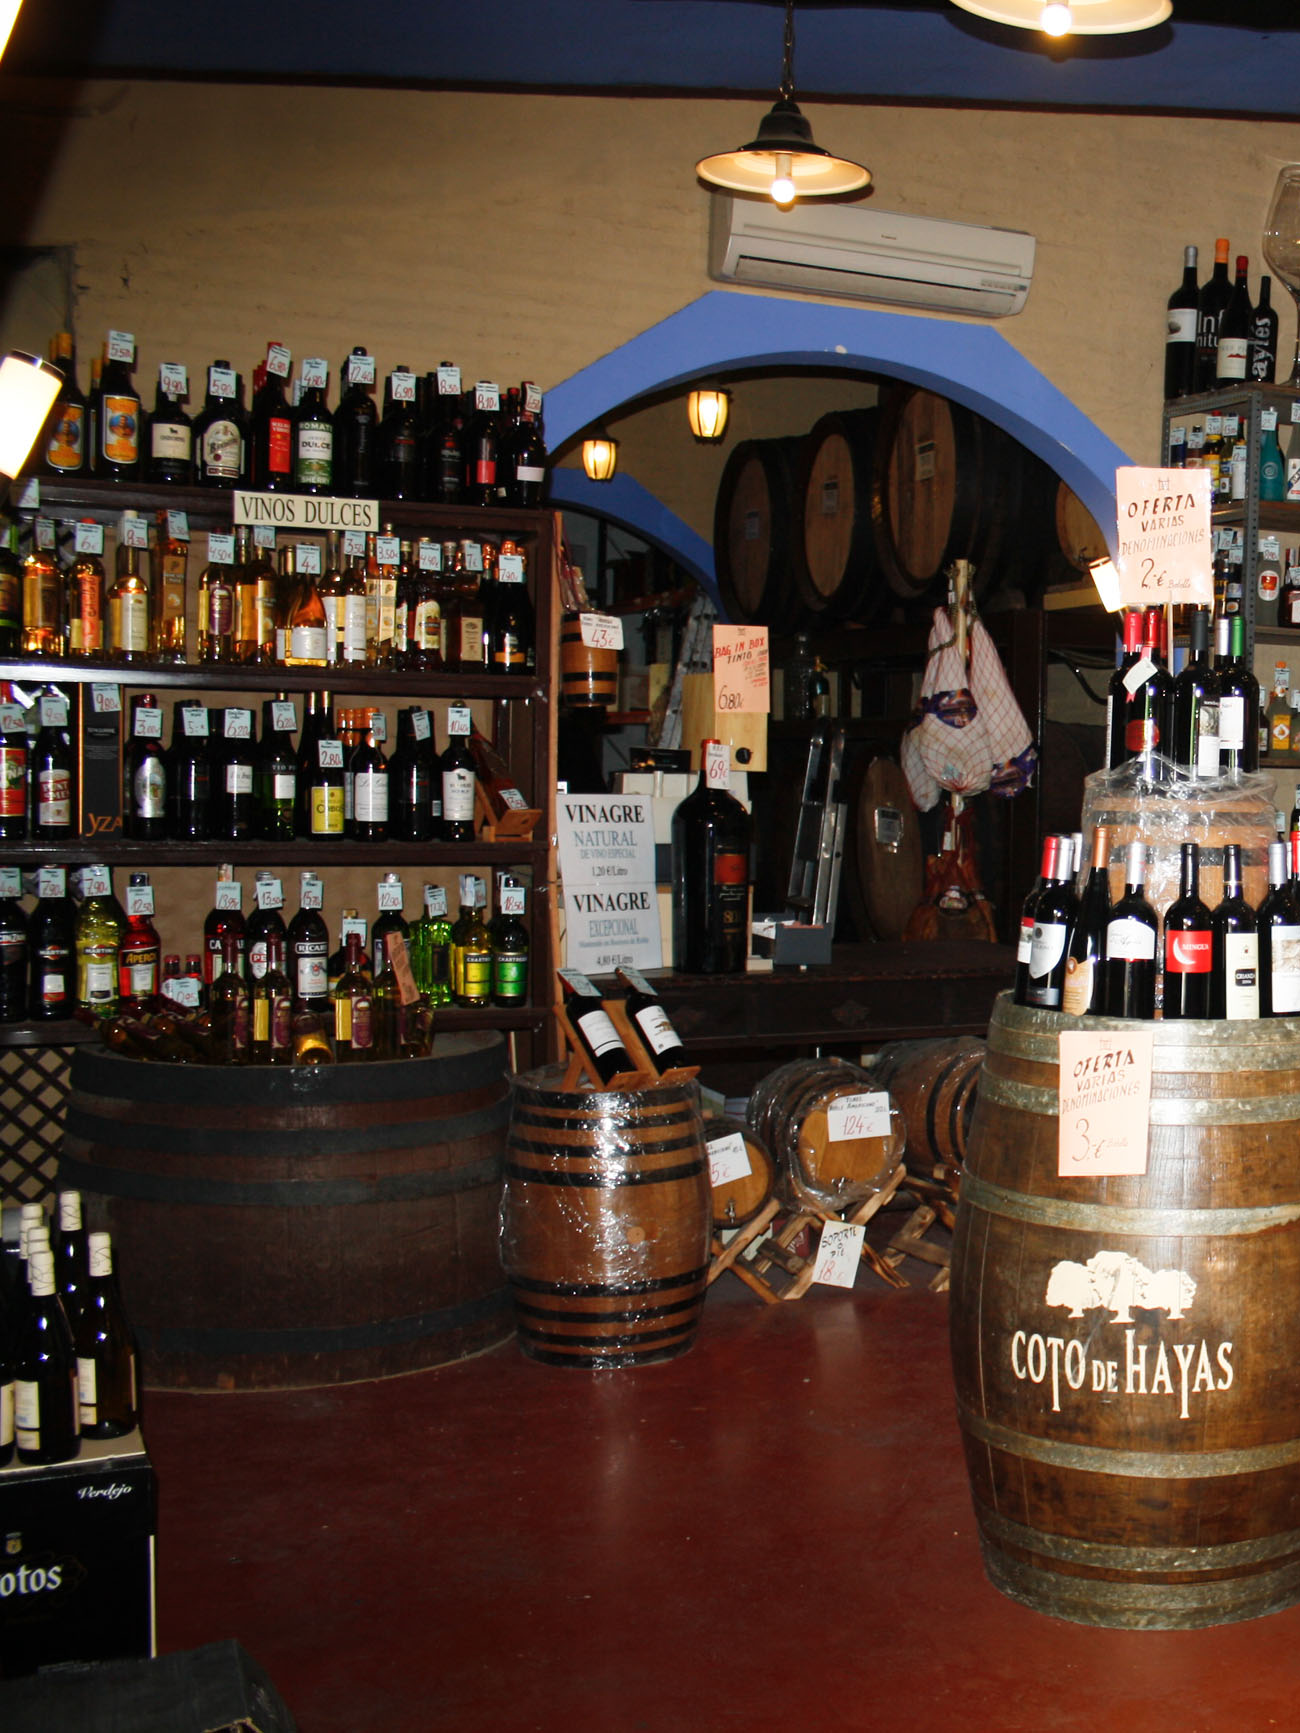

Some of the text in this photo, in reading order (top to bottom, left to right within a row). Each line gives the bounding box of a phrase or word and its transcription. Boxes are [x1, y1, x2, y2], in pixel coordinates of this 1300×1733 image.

[240, 496, 372, 528] VINOS DULCES
[1128, 493, 1196, 519] OFERTA
[1141, 515, 1185, 533] VARIAS
[1121, 528, 1205, 556] DENOMINACIONES
[715, 637, 765, 658] BAG IN BOX
[565, 804, 645, 824] VINAGRE
[574, 830, 637, 847] NATURAL
[573, 892, 650, 913] VINAGRE
[589, 918, 639, 938] EXCEPCIONAL
[1073, 1049, 1135, 1078] OFERTA
[1077, 1069, 1125, 1092] VARIAS
[1062, 1081, 1141, 1115] DENOMINACIONES
[821, 1225, 857, 1250] SOPORTE
[1011, 1329, 1234, 1419] COTO DE HAYAS
[77, 1483, 133, 1500] Verdejo
